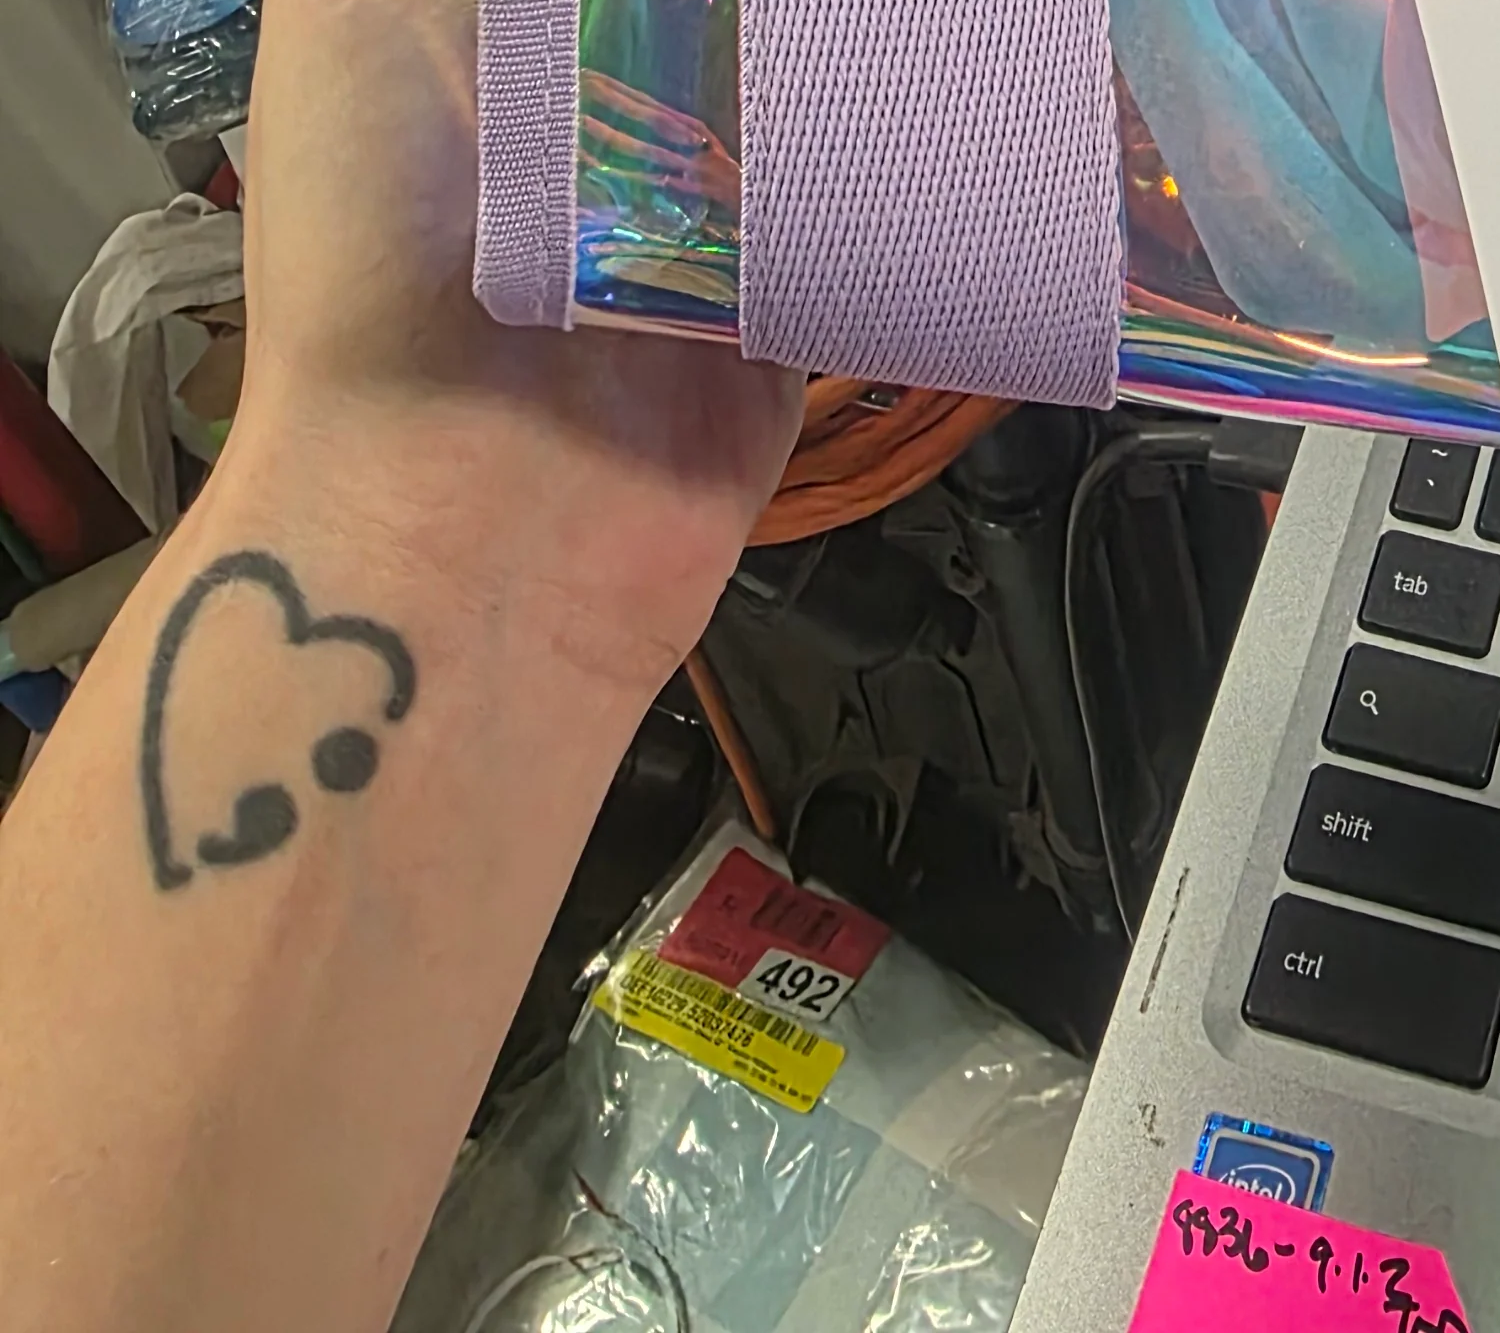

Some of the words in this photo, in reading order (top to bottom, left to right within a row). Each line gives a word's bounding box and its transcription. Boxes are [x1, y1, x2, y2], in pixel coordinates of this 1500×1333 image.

[1394, 571, 1428, 596] tab
[1321, 811, 1373, 842] shift
[1284, 951, 1323, 979] ctrl
[755, 958, 841, 1014] 492
